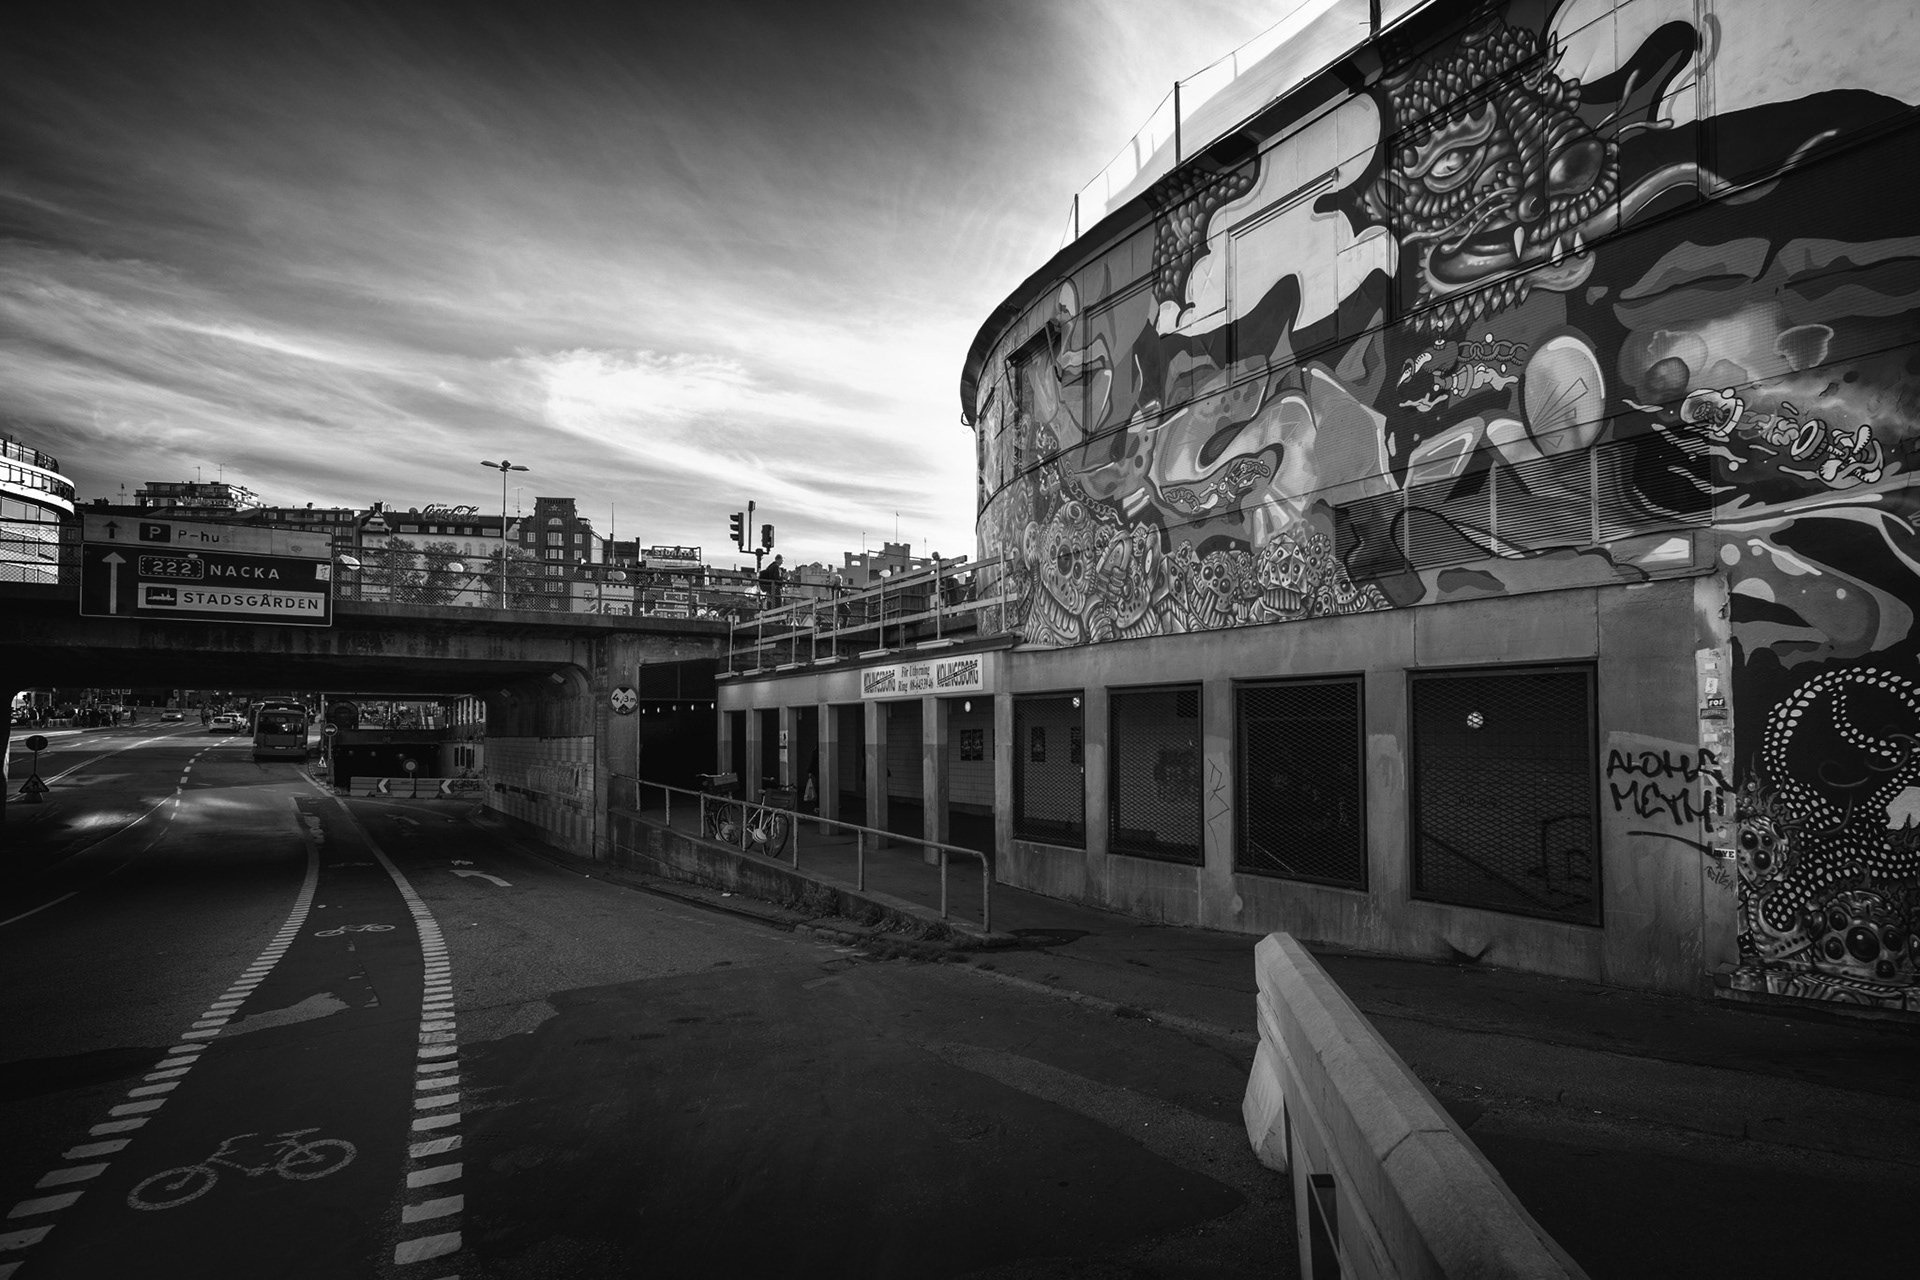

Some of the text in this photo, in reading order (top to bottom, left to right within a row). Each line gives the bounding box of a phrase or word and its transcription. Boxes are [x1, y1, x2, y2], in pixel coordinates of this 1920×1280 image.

[149, 526, 162, 539] P
[152, 560, 192, 574] 222
[209, 564, 280, 580] NACKA
[183, 592, 319, 610] STADSGÅRDEN
